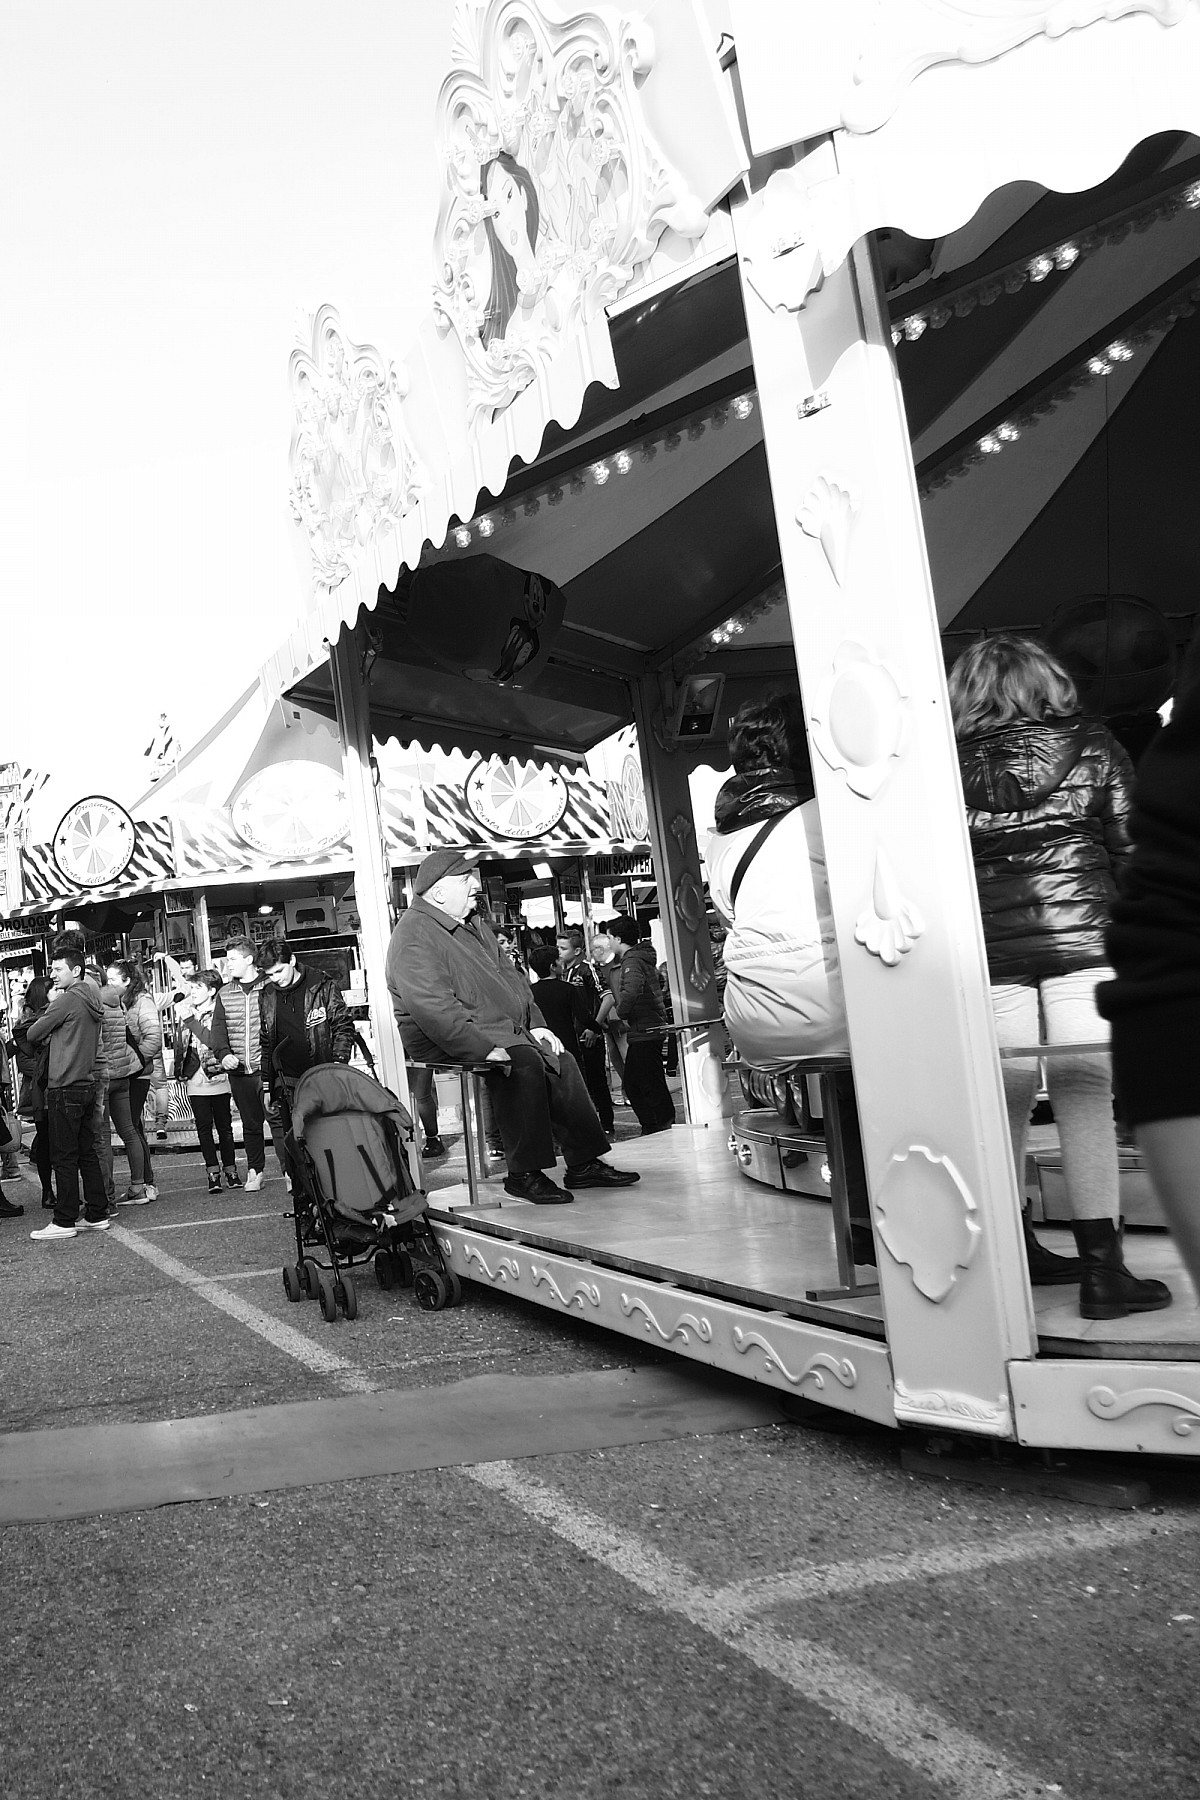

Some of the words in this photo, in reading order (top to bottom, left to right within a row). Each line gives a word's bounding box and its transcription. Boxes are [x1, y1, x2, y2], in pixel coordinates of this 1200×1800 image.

[473, 799, 500, 831] Ruota
[504, 827, 530, 836] della
[535, 796, 564, 834] Fortuna
[60, 855, 82, 881] Ruota
[84, 875, 106, 884] della
[109, 837, 132, 877] Fortuna
[594, 856, 612, 876] MINI
[612, 854, 651, 875] SCOOTER
